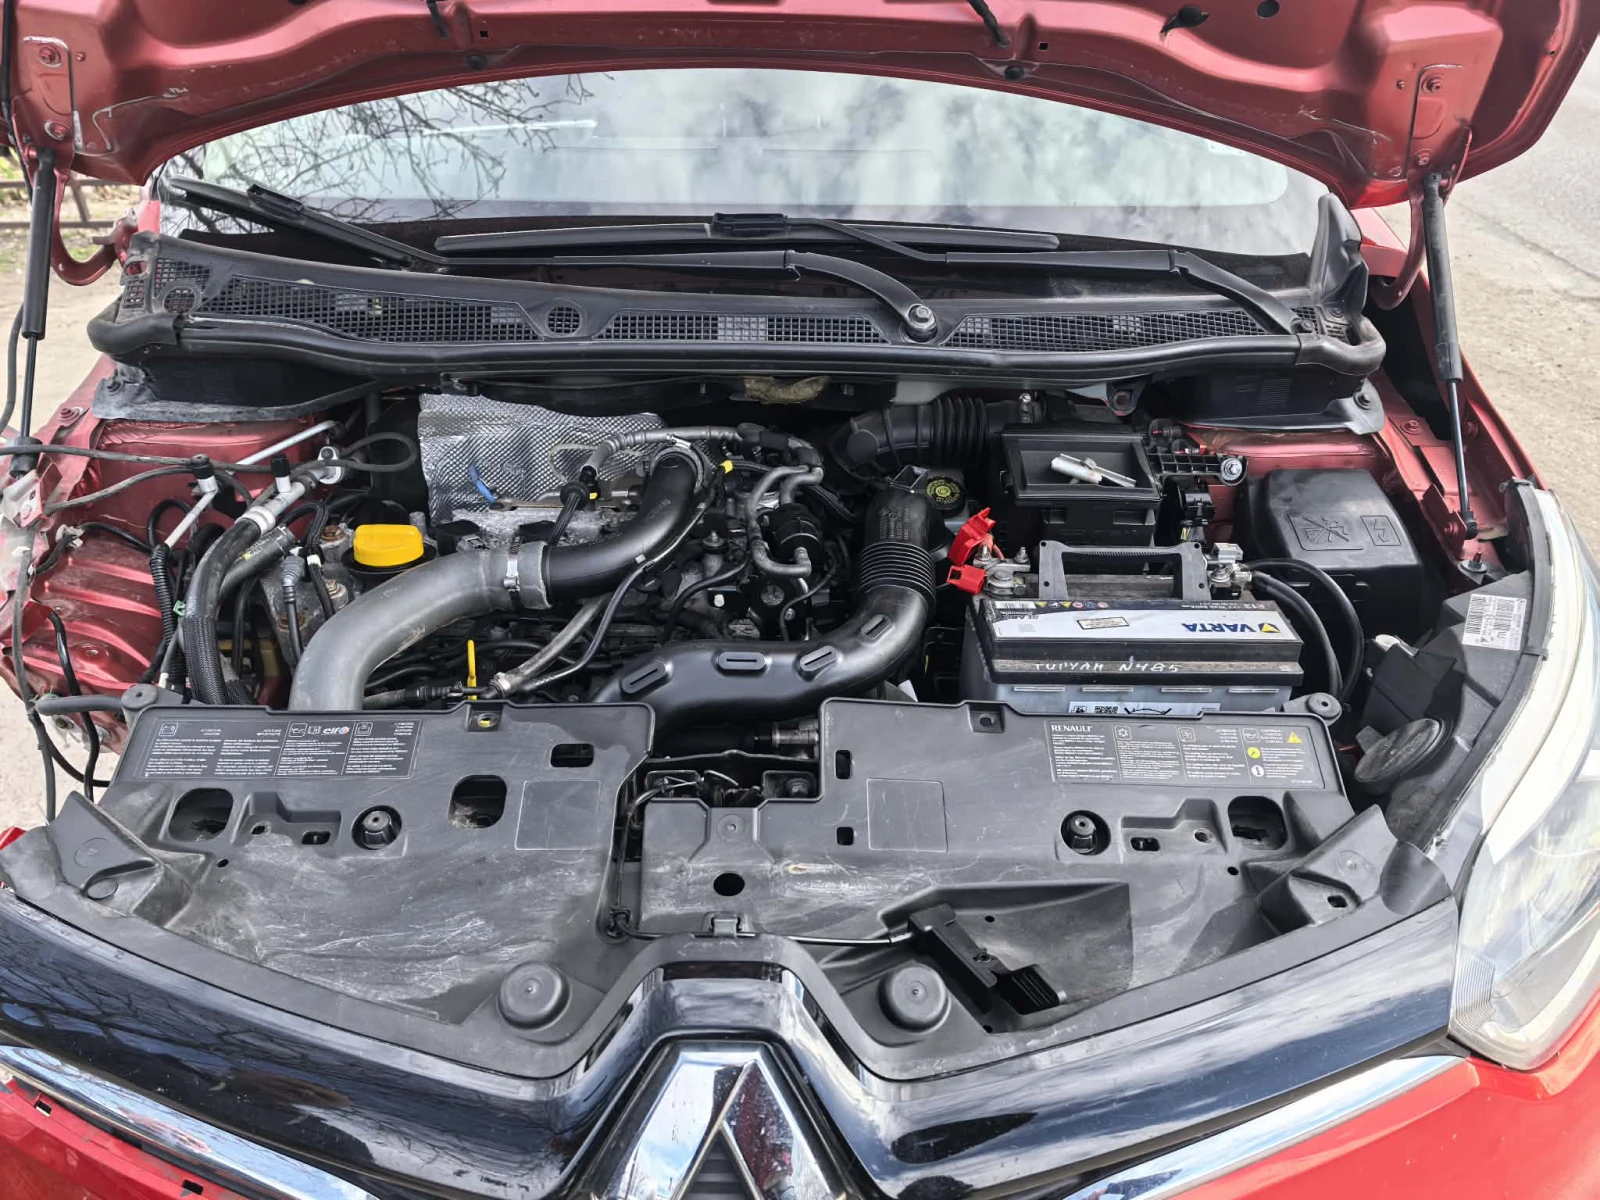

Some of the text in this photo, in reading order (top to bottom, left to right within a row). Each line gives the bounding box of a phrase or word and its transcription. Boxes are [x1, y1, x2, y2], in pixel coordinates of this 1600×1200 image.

[1181, 622, 1257, 633] VARTA
[322, 727, 341, 735] elf
[1050, 724, 1093, 732] RENAULT
